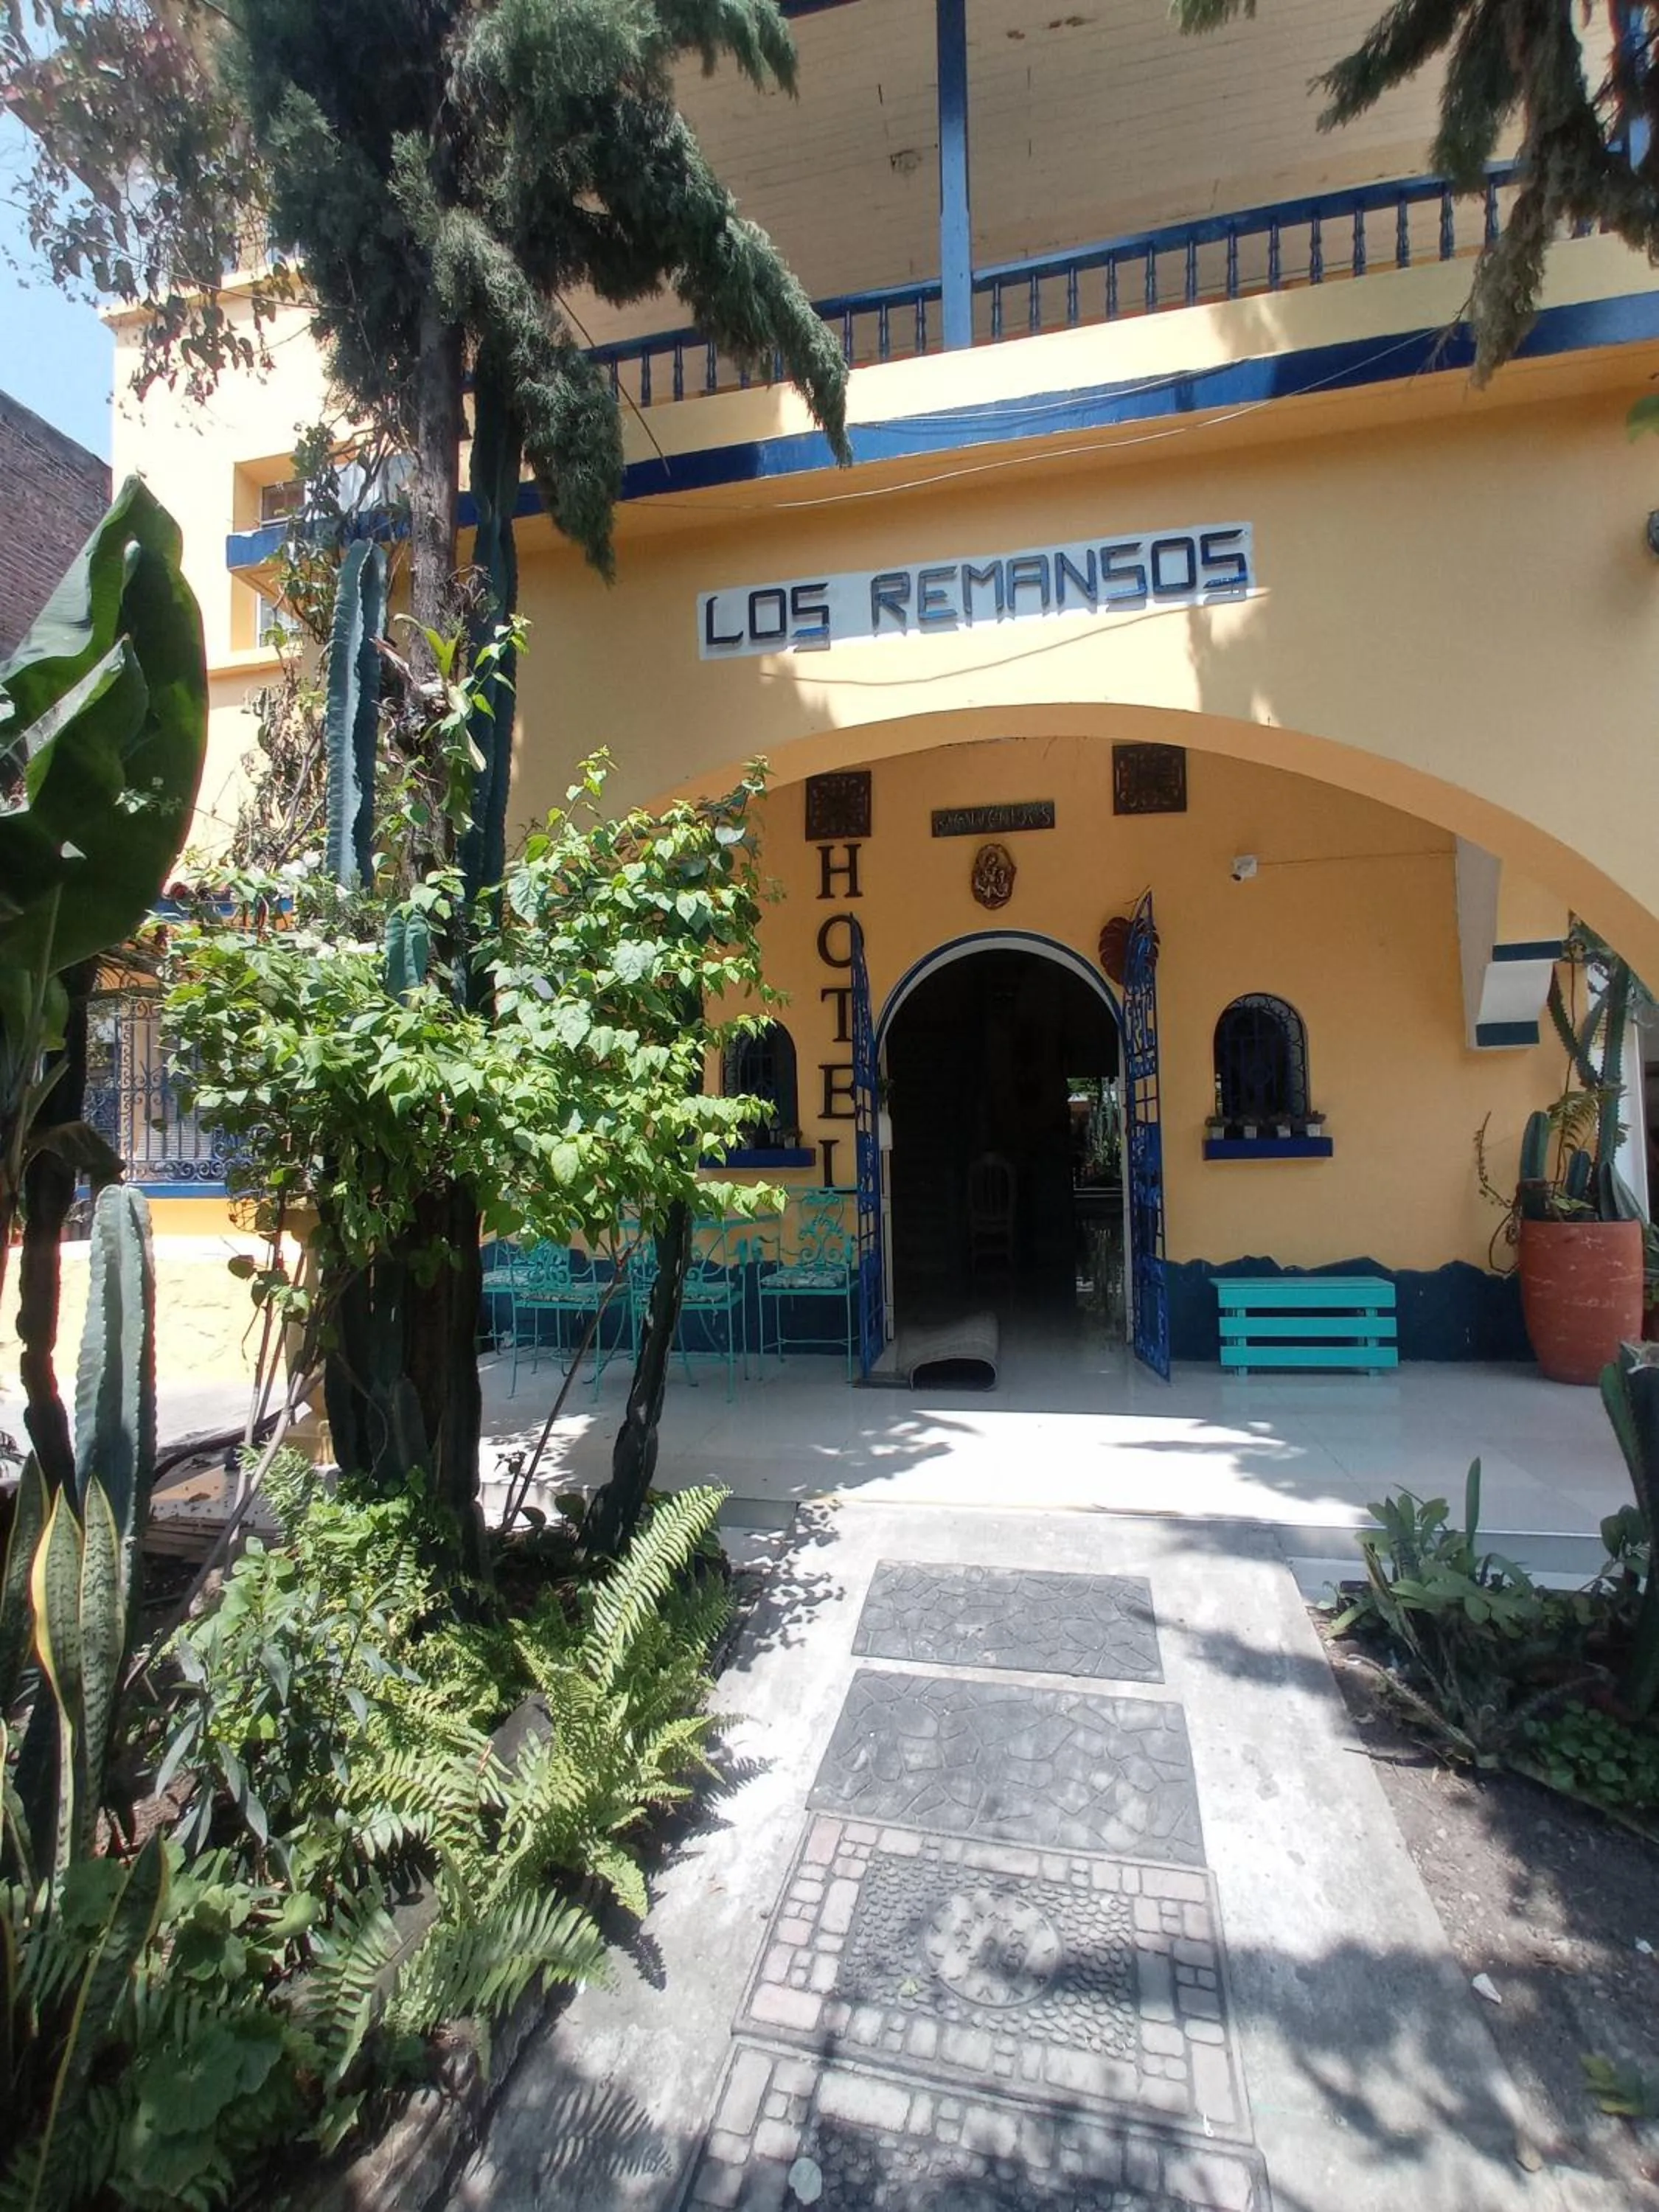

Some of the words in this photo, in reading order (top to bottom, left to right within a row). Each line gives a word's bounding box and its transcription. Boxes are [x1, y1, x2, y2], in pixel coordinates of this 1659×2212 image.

[706, 582, 830, 649] LOS
[871, 529, 1249, 634] REMANSOS
[816, 844, 864, 1195] HOTEL
